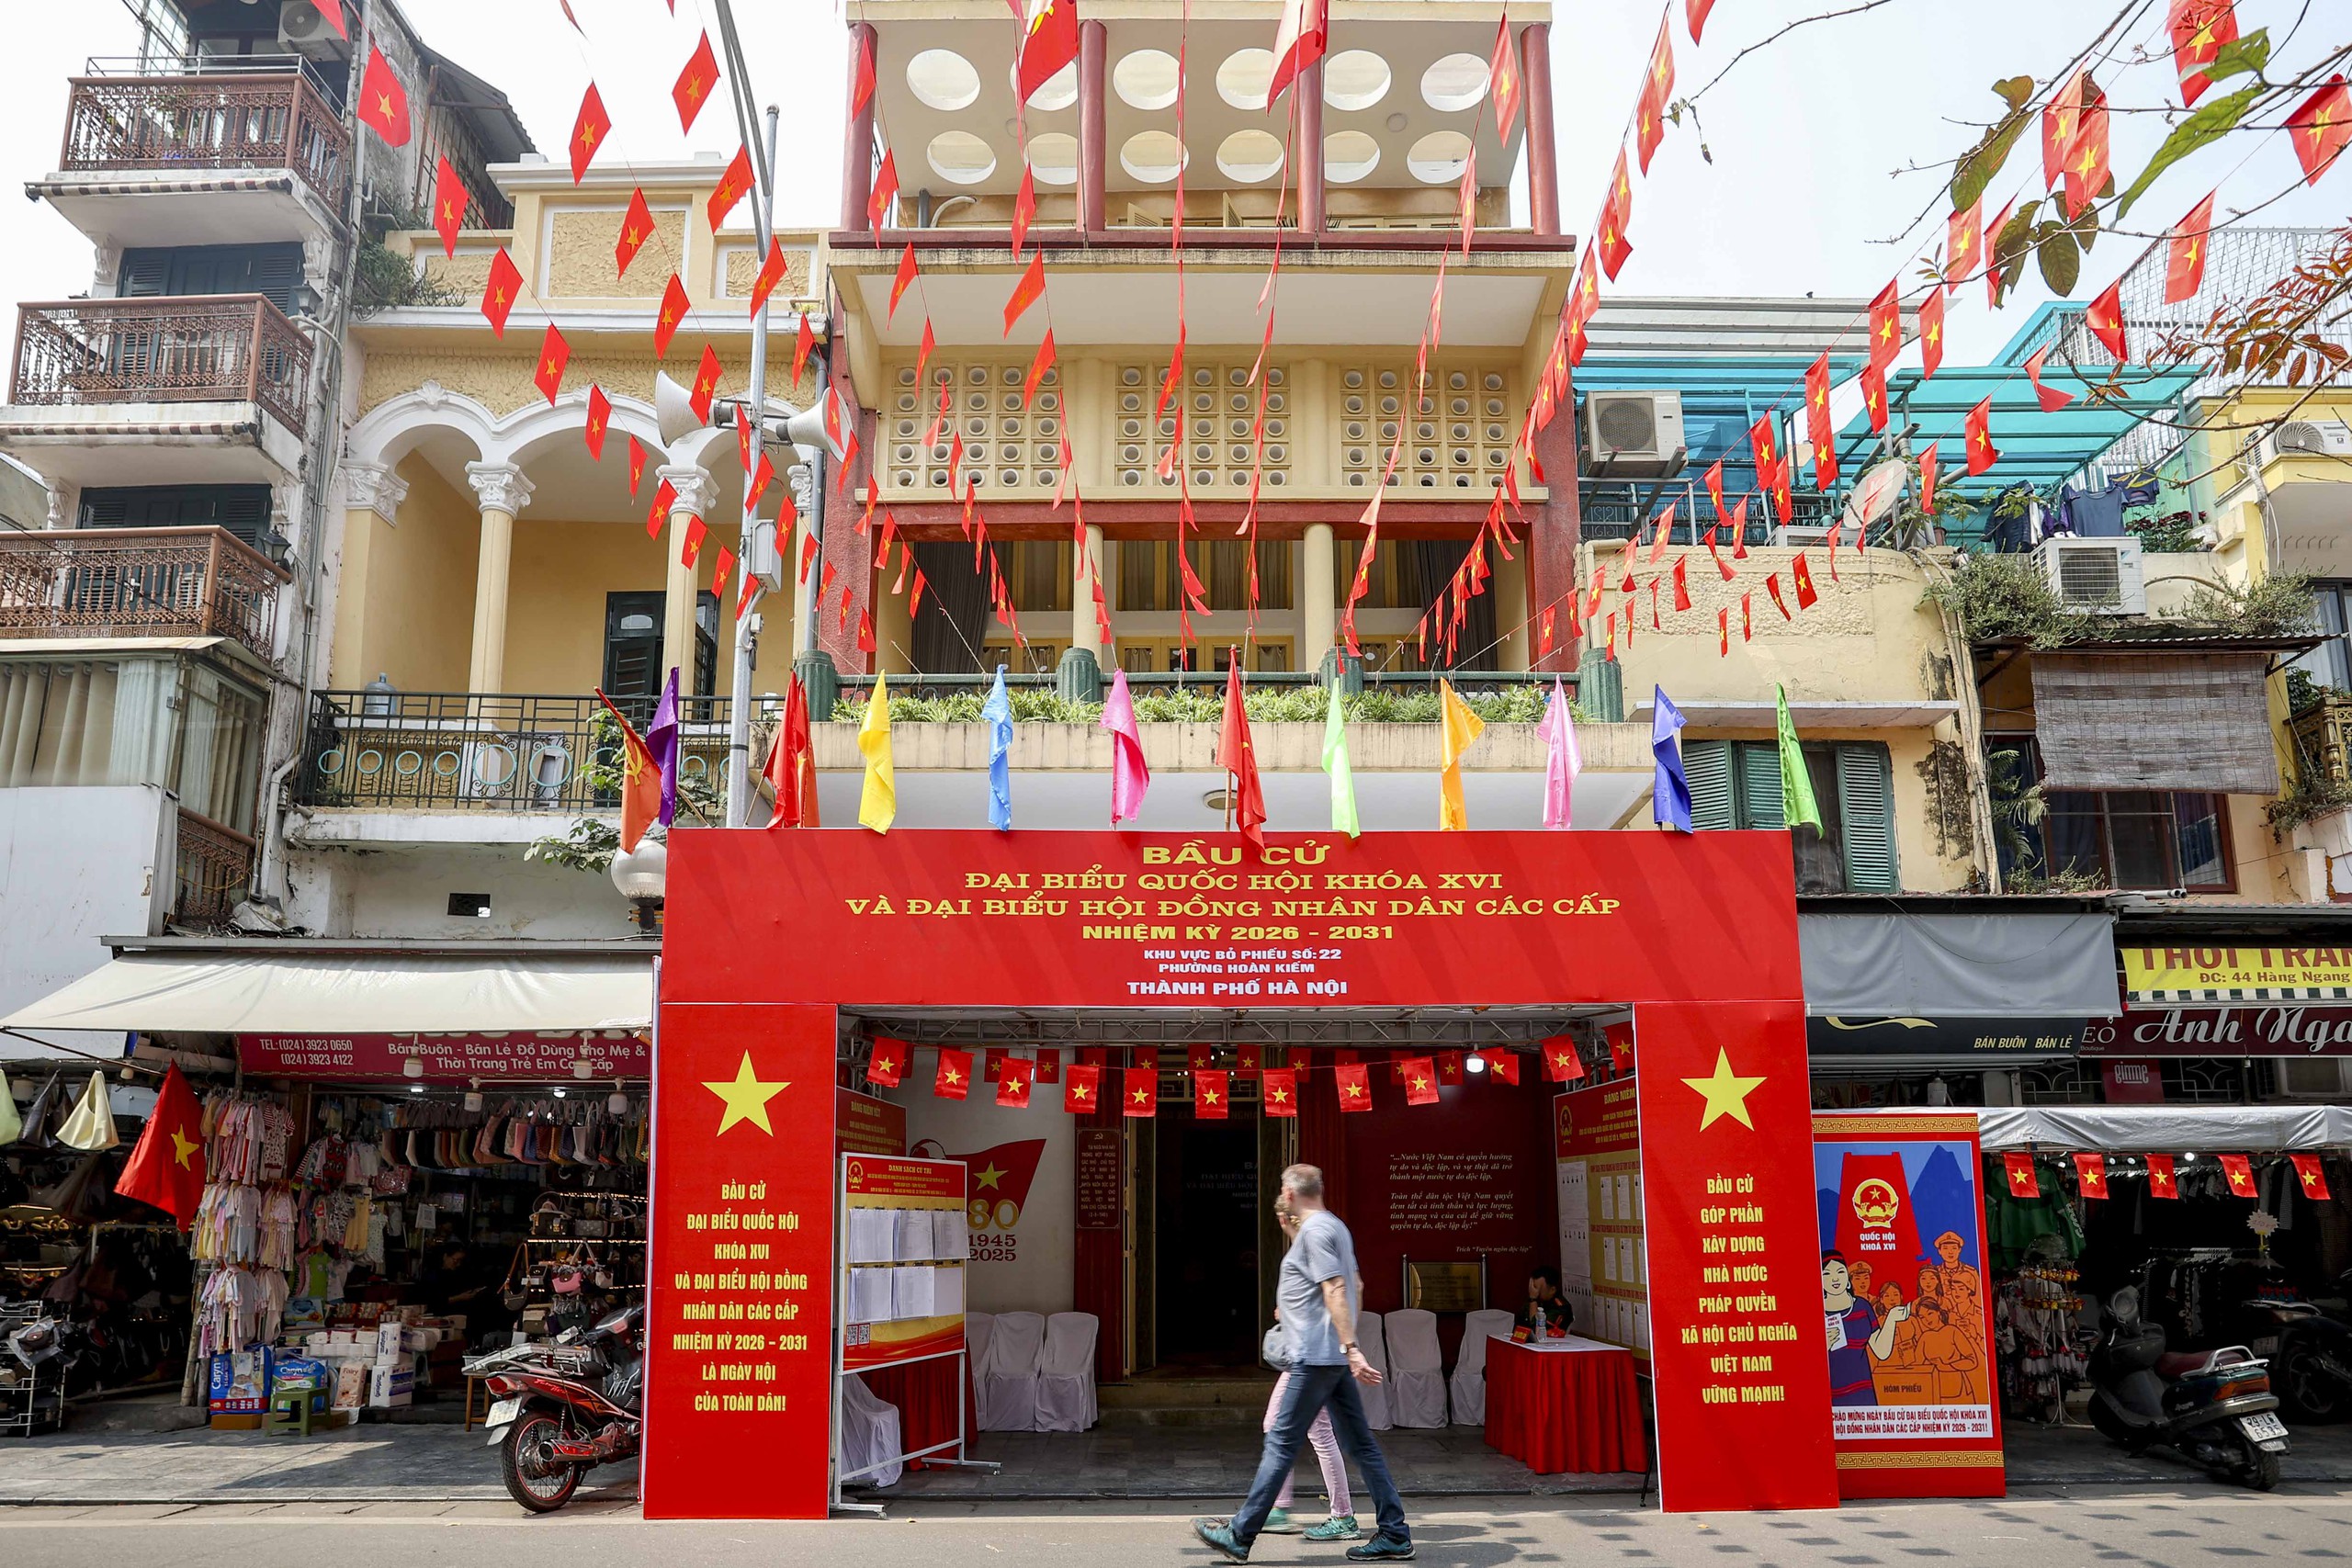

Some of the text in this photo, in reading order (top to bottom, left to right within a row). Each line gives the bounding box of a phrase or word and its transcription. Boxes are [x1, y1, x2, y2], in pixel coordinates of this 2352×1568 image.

[1143, 839, 1331, 865] BẦU CỬ
[965, 863, 1503, 894] ĐẠI BIỂU QUỐC HỘI KHÓA XVI
[844, 890, 1621, 920] VÀ ĐẠI BIỂU HỘI ĐỒNG NHÂN DÂN CÁC CẤP
[1082, 923, 1393, 942] NHIỆM KỲ 2026 2031
[1144, 946, 1342, 962] KHU VỰC BỎ PHIẾU SỐ:22
[1159, 960, 1315, 974] PHƯỜNG HOÀN KIẾM
[2199, 972, 2350, 983] ĐC: 44 Hàng Ngang
[1126, 977, 1348, 997] THÀNH PHỐ HÀ NỘI
[2133, 1009, 2243, 1043] Anh
[305, 1040, 328, 1051] 3923
[331, 1040, 353, 1051] 0650
[420, 1043, 452, 1055] Buôn
[466, 1043, 491, 1055] Bán
[496, 1042, 511, 1055] Lẻ
[516, 1043, 536, 1055] Đồ
[540, 1043, 575, 1058] Dùng
[610, 1045, 630, 1059] Mẹ
[636, 1045, 645, 1056] &
[1973, 1034, 2073, 1049] BÁN BUÔN BÁN LẺ
[281, 1054, 353, 1066] (024) 3923 4122
[436, 1057, 465, 1069] Thời
[469, 1058, 507, 1071] Trang
[511, 1056, 531, 1069] Trẻ
[537, 1058, 556, 1069] Em
[2114, 1061, 2149, 1084] gimme
[721, 1178, 766, 1201] BẦU CỬ
[1706, 1172, 1754, 1194] BẦU CỬ
[686, 1207, 799, 1234] ĐẠI BIỂU QUỐC HỘI
[968, 1199, 1019, 1231] 80
[1700, 1201, 1763, 1224] GÓP PHẦN
[968, 1235, 1016, 1247] 1945
[1702, 1234, 1765, 1256] XÂY DỰNG
[1860, 1231, 1895, 1242] QUỐC HỘI
[1883, 1243, 1896, 1251] XVI
[714, 1240, 770, 1260] KHÓA XVI
[967, 1248, 1016, 1262] 2025
[674, 1267, 808, 1293] VÀ ĐẠI BIỂU HỘI ĐỒNG
[1703, 1263, 1768, 1283] NHÀ NƯỚC
[683, 1298, 799, 1320] NHÂN DÂN CÁC CẤP
[1698, 1290, 1777, 1314] PHÁP QUYỀN
[673, 1331, 808, 1354] NHIỆM KỲ 2026 2031
[1681, 1321, 1798, 1347] XÃ HỘI CHỦ NGHĨA
[702, 1360, 776, 1384] LÀ NGÀY HỘI
[1710, 1353, 1772, 1376] VIỆT NAM
[211, 1362, 224, 1390] Caryn
[695, 1390, 786, 1412] CỦA TOÀN DÂN!
[1702, 1384, 1785, 1405] VỮNG MẠNH!
[1849, 1410, 1865, 1421] MỪNG
[1867, 1410, 1882, 1420] NGÀY
[1906, 1411, 1917, 1422] ĐẠI
[1932, 1408, 1948, 1420] QUỐC
[1950, 1409, 1959, 1421] HỘI
[1961, 1409, 1976, 1420] KHÓA
[1978, 1411, 1987, 1419] XVI
[2246, 1413, 2275, 1427] 29-L6
[1865, 1423, 1882, 1434] NHÂN
[1883, 1423, 1894, 1433] DÂN
[1896, 1422, 1907, 1433] CÁC
[1922, 1422, 1941, 1435] NHIỆM
[1951, 1424, 1966, 1432] 2026
